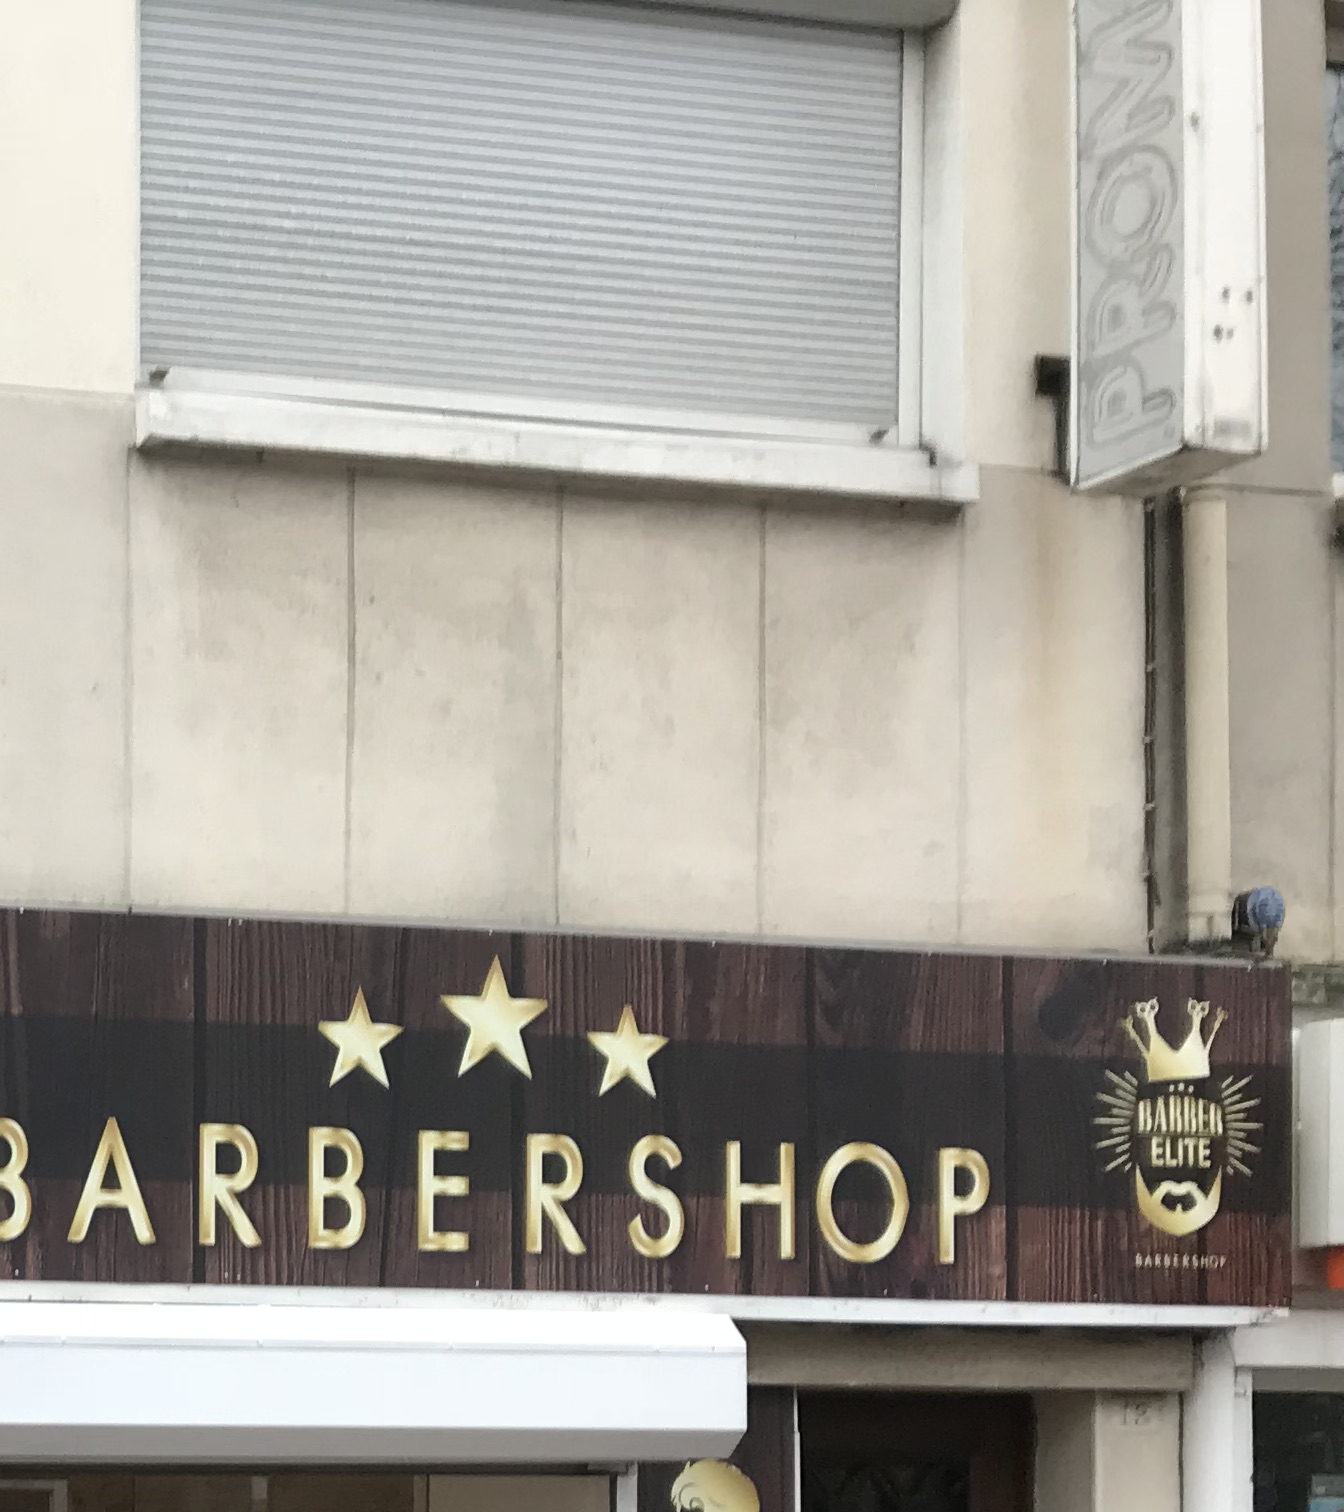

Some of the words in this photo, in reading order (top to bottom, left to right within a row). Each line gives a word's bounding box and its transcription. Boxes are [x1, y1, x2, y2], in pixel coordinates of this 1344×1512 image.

[1138, 1095, 1223, 1135] BARBER
[1151, 1137, 1211, 1169] ELITE
[1135, 1252, 1228, 1269] BARBERSHOP
